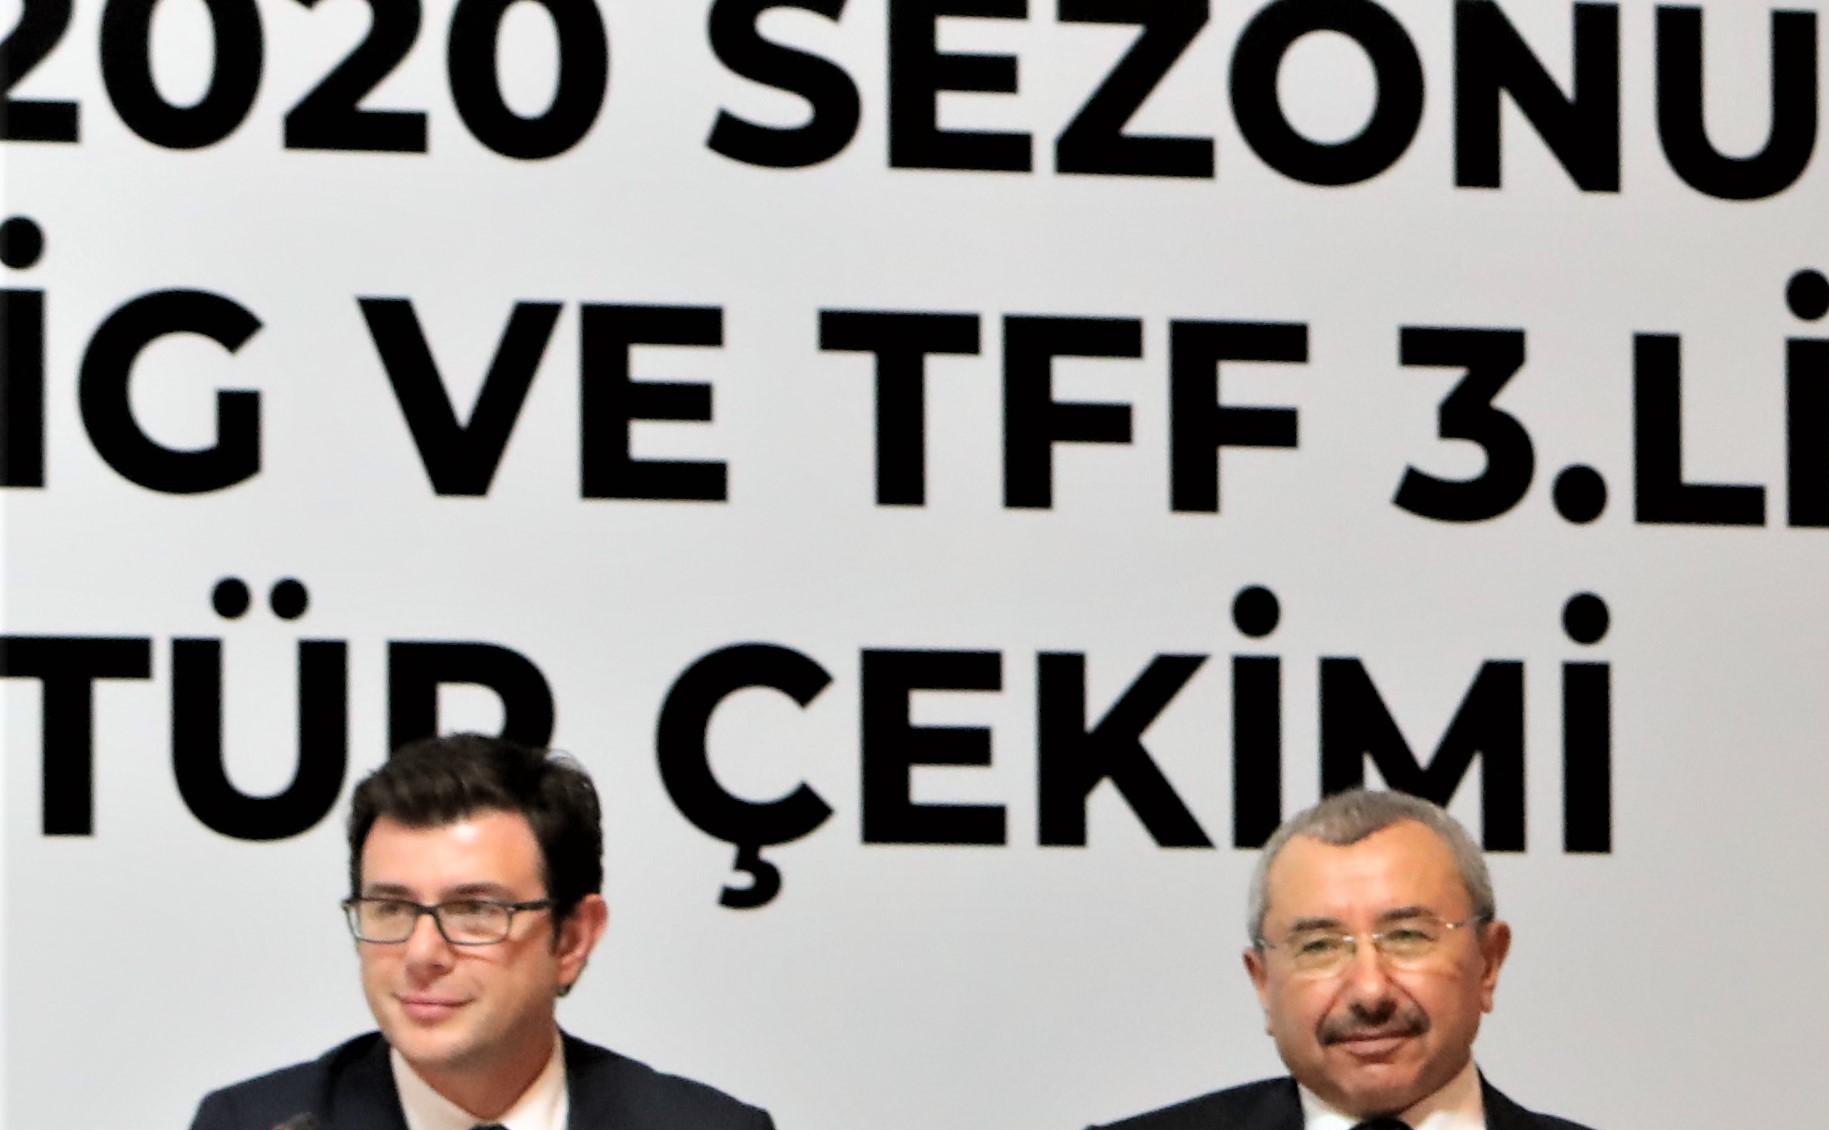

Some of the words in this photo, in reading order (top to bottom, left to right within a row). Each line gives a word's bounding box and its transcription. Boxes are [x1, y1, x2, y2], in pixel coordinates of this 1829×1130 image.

[706, 0, 1820, 202] SEZONU
[357, 297, 728, 504] VE
[818, 309, 1309, 514] TFF
[655, 584, 1613, 910] ÇEKİMİ
